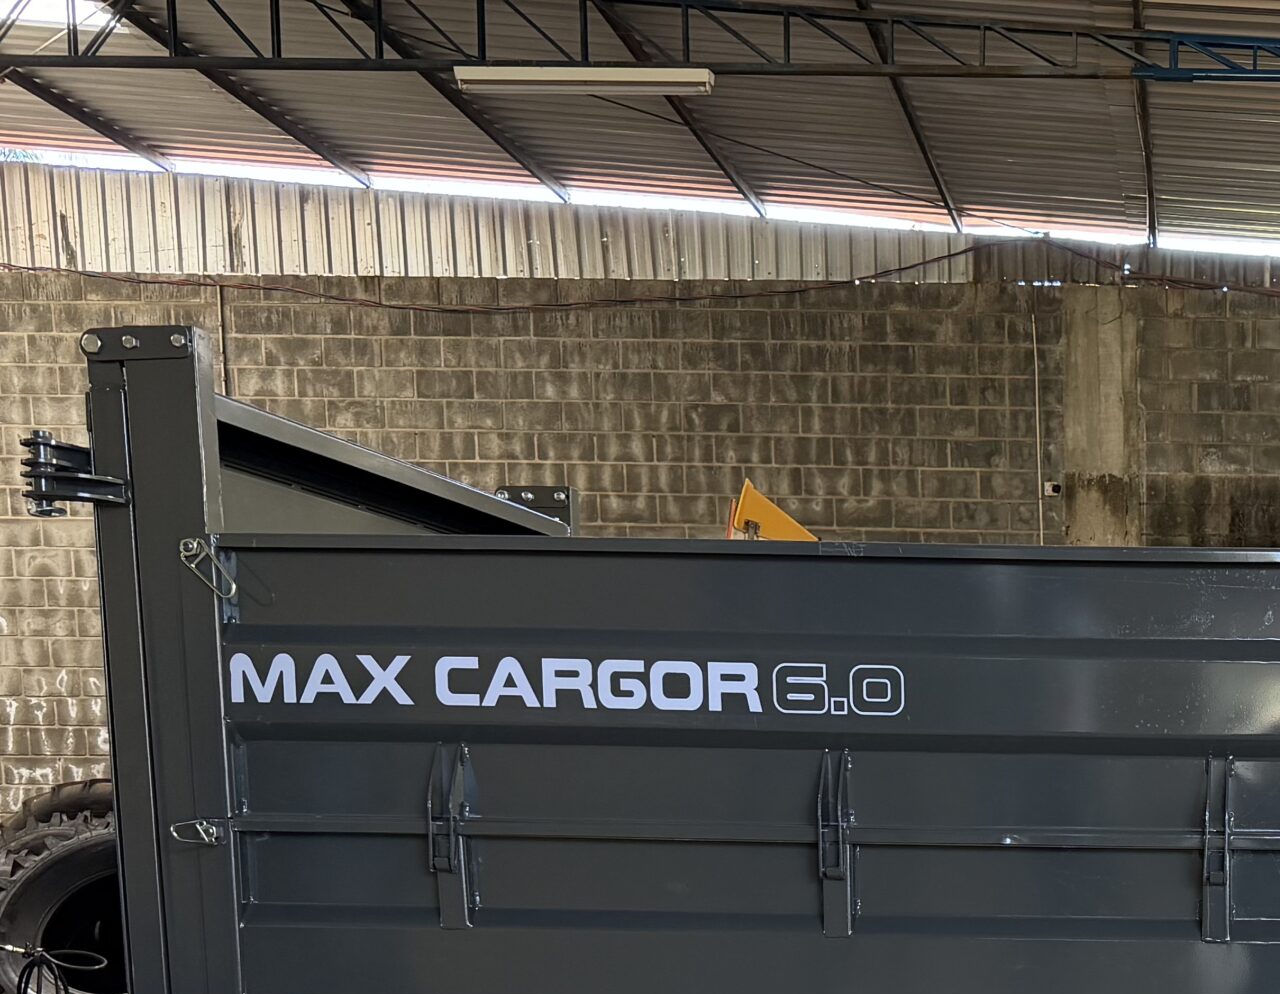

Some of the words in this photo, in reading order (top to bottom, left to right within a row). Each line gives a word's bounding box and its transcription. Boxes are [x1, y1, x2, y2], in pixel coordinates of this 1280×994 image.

[229, 652, 414, 706] MAX
[434, 655, 763, 713] CARGOR
[772, 662, 906, 715] 6.0
